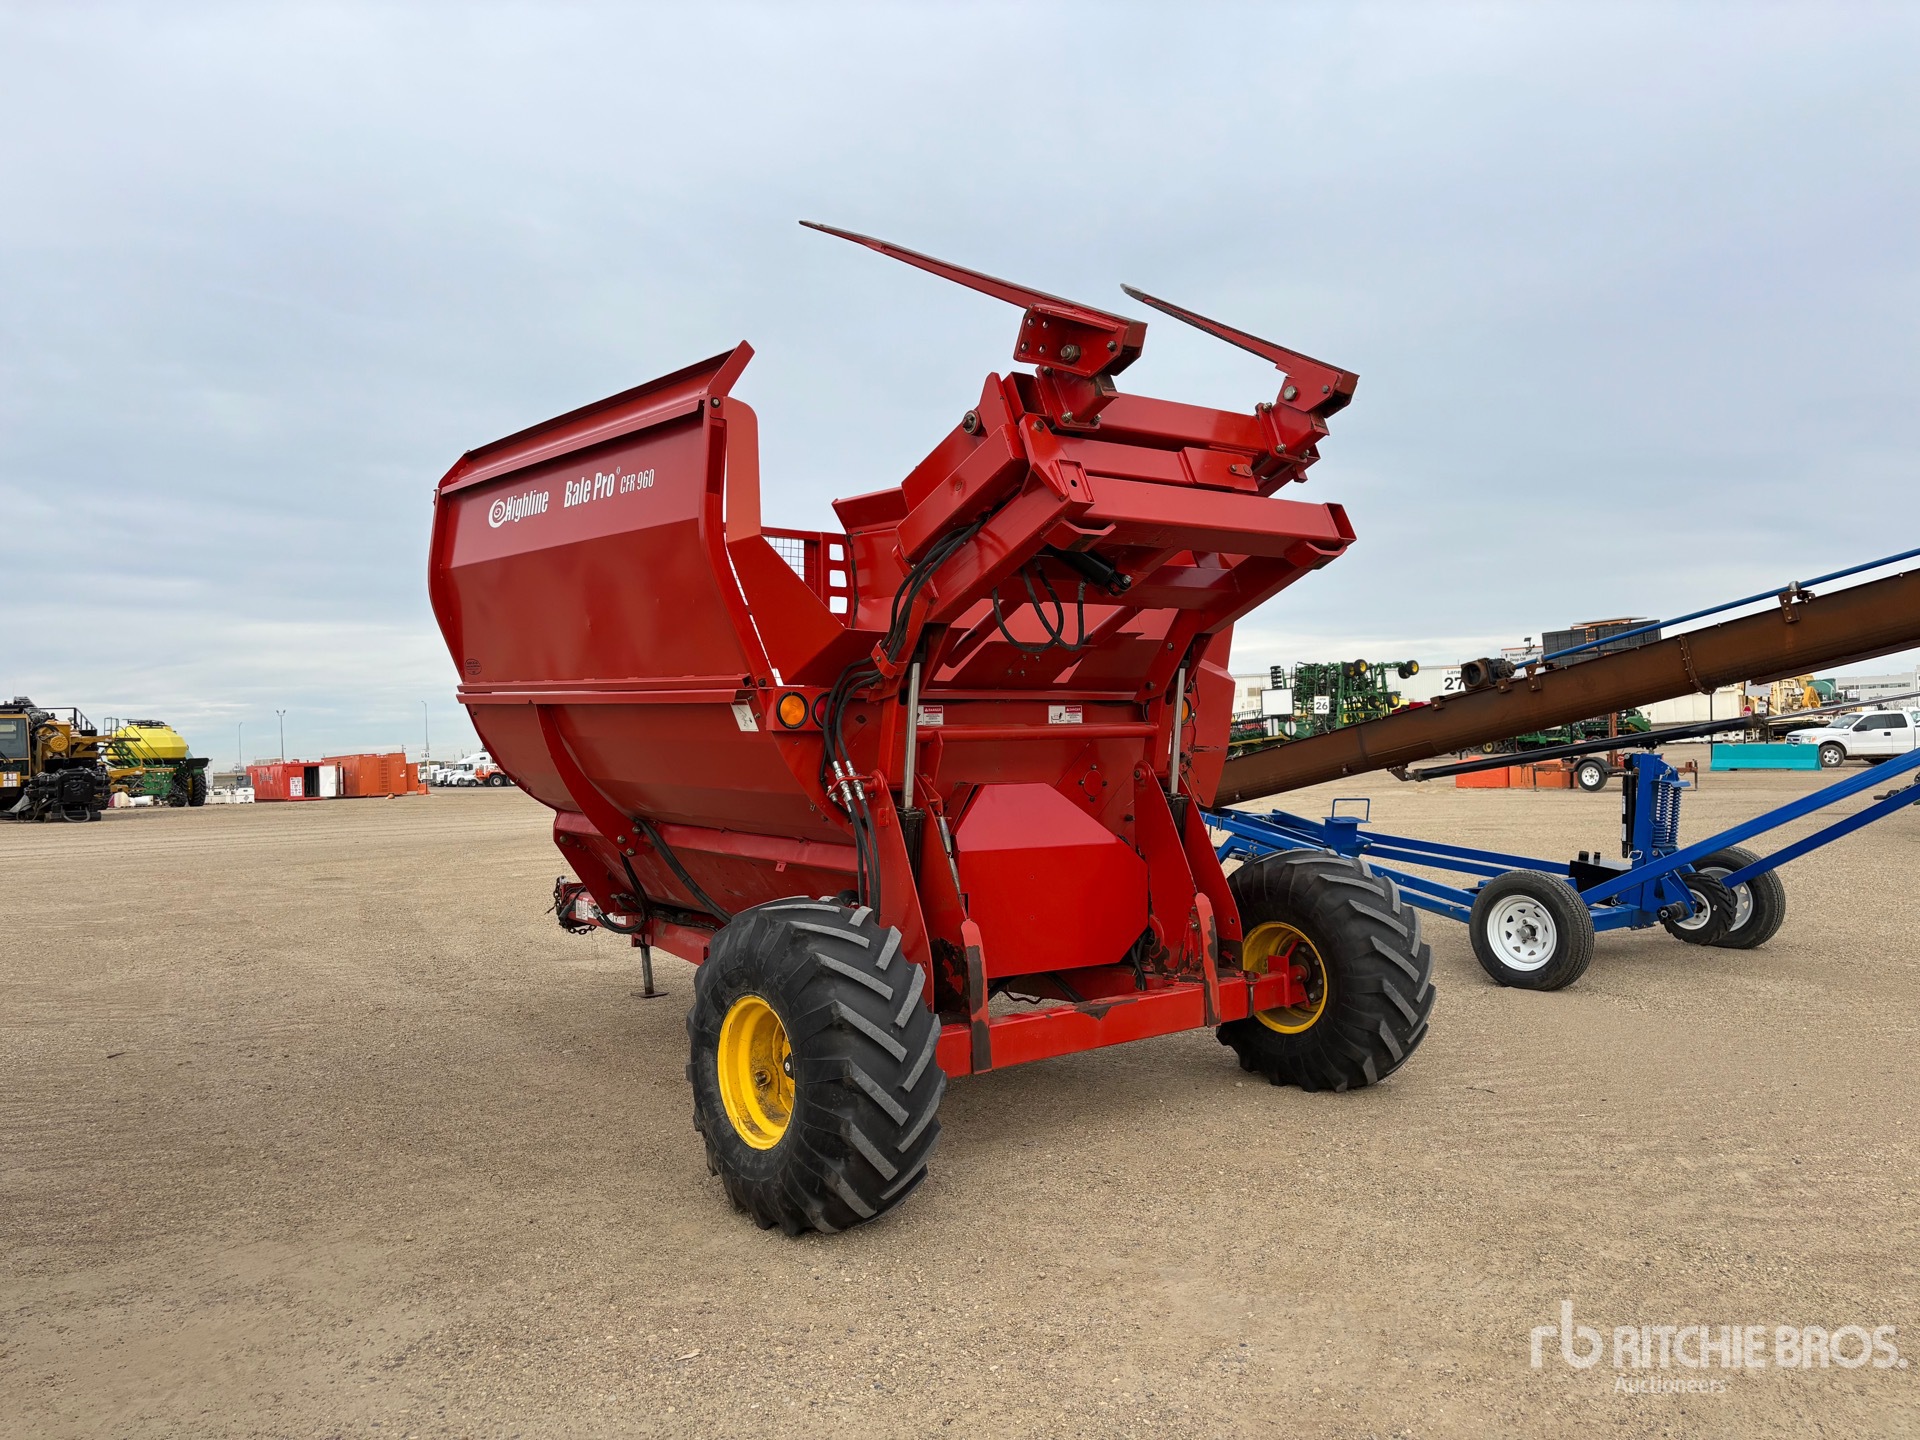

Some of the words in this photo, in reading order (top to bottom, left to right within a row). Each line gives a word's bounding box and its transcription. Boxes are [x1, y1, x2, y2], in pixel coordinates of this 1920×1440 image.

[563, 477, 592, 508] Bale
[619, 475, 635, 494] CFR
[637, 468, 655, 491] 960
[505, 490, 549, 523] Highline
[1444, 677, 1462, 690] 27
[1316, 702, 1328, 710] 26
